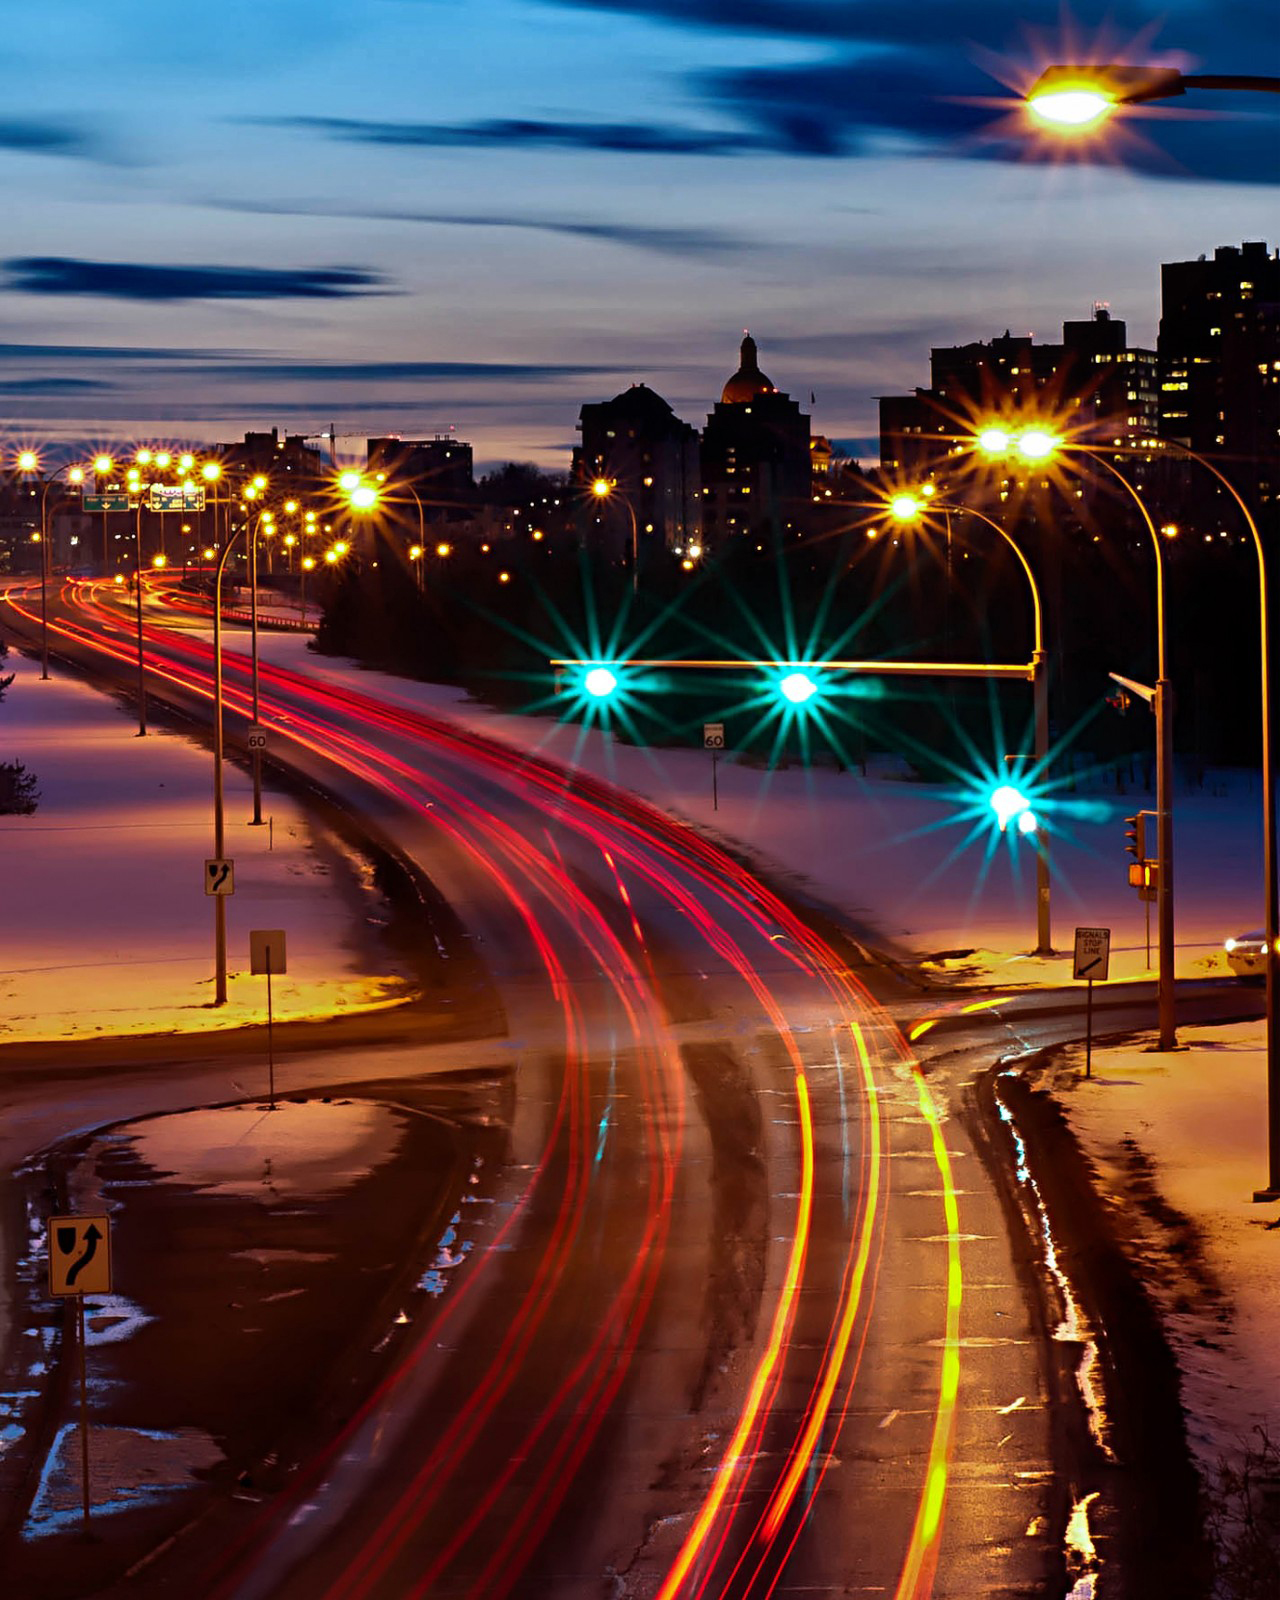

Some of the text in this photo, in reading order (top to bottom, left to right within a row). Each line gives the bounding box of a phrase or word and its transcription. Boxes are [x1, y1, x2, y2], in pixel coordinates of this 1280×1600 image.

[249, 736, 266, 747] 60
[705, 735, 723, 747] 60
[1076, 931, 1108, 939] SIGNALS
[1083, 939, 1103, 947] STOP
[1083, 947, 1100, 955] LINE
